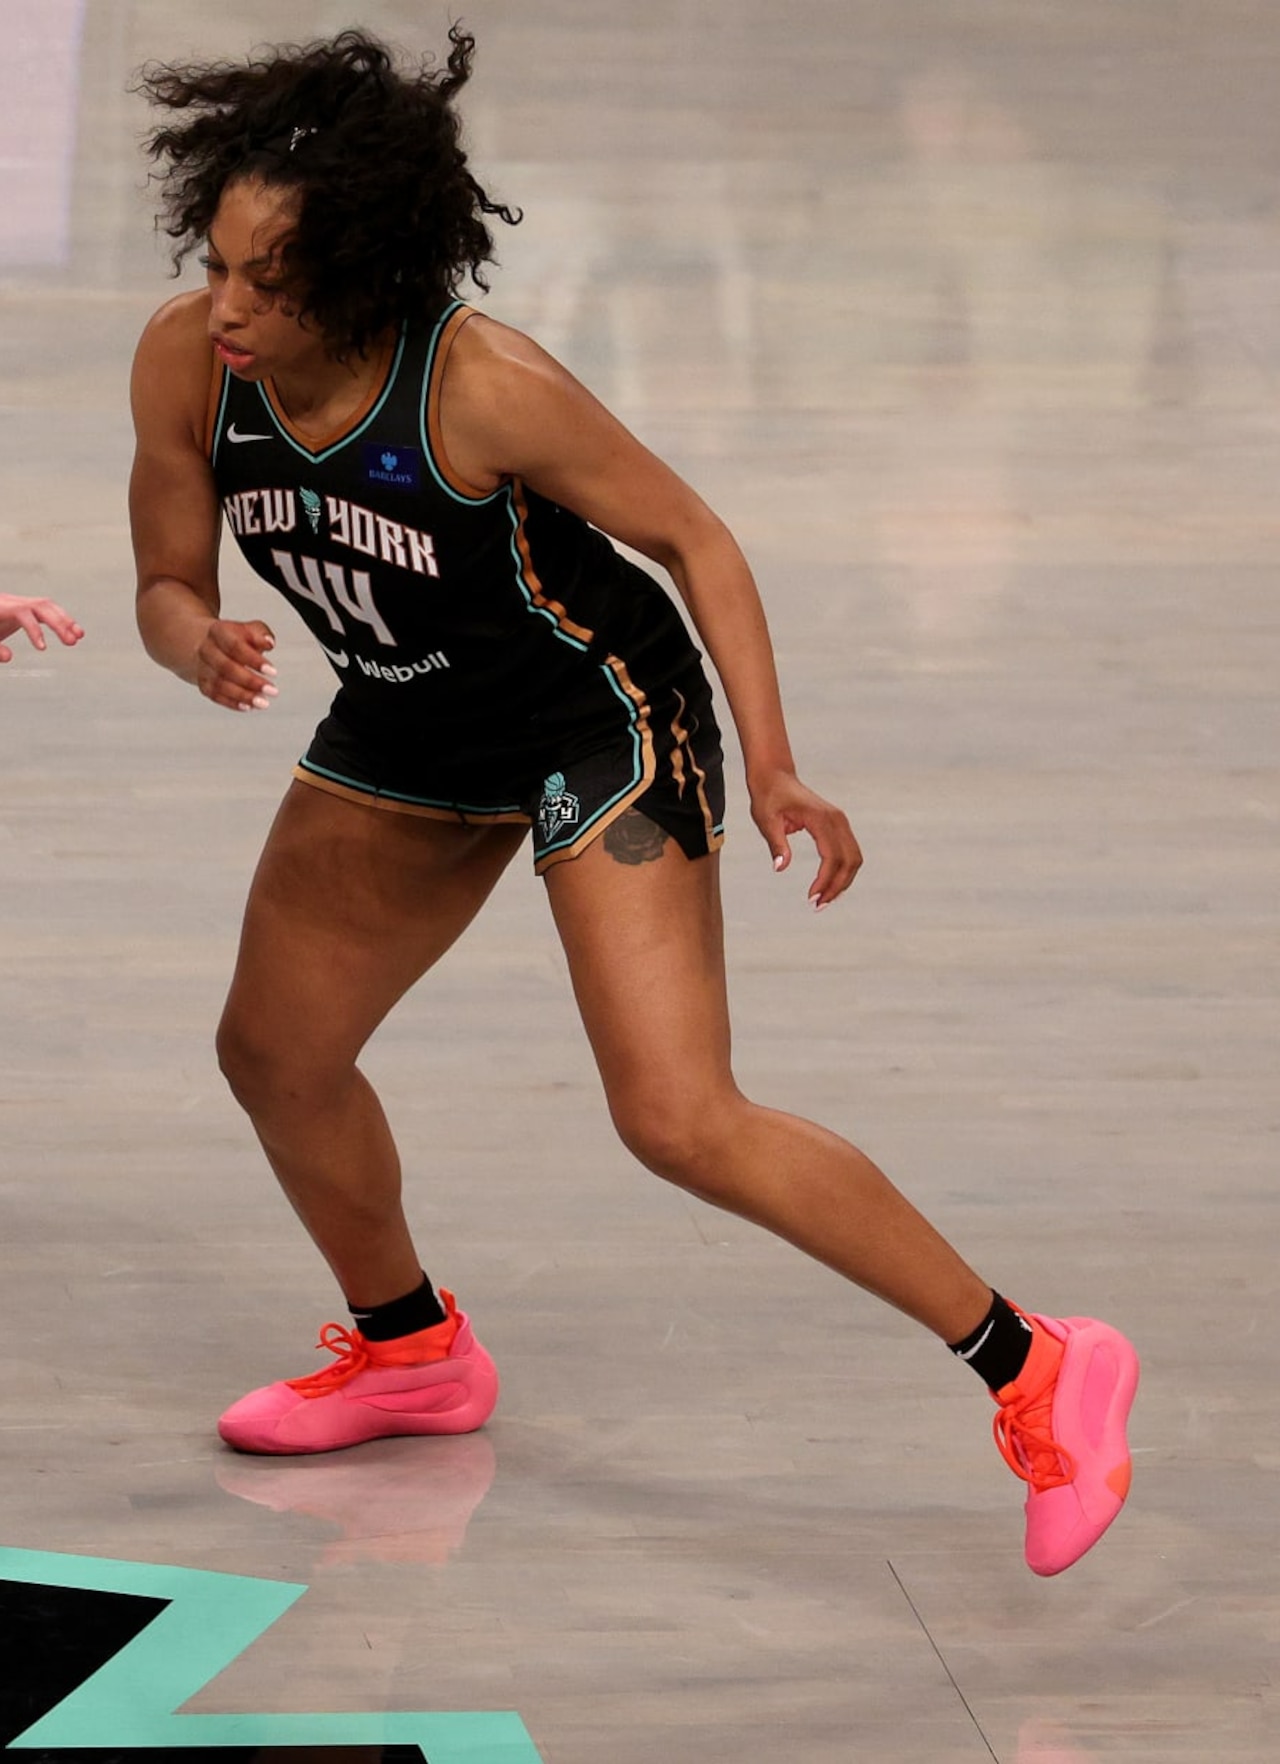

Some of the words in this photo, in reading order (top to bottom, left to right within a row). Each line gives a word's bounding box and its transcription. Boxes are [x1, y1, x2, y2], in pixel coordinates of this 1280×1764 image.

[368, 469, 413, 484] BARCLAYS
[223, 488, 297, 536] NEW
[324, 494, 441, 580] YORK
[270, 548, 398, 648] 44
[355, 650, 451, 683] Webull
